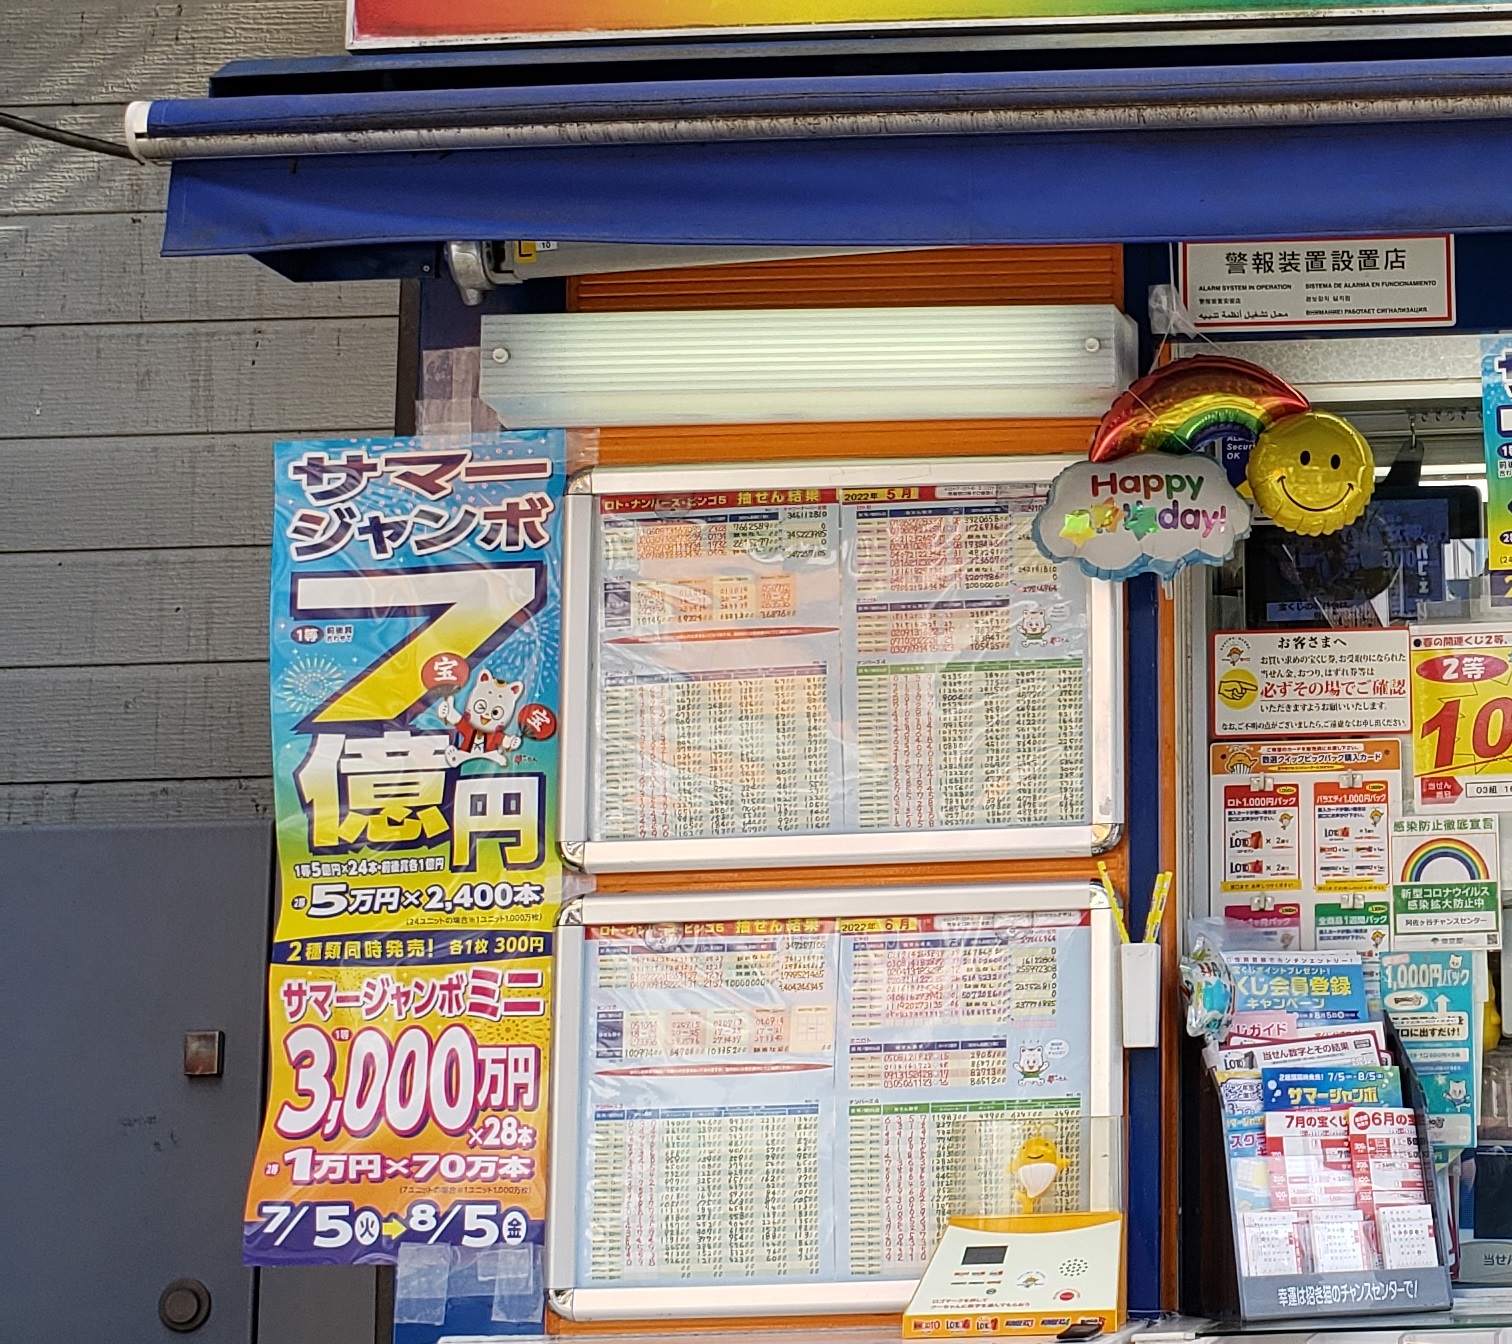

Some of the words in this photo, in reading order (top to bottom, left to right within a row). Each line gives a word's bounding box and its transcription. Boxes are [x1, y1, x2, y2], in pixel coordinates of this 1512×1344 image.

[1225, 248, 1407, 274] 警報装置設置店
[288, 450, 553, 506] サマー
[1091, 472, 1204, 501] Happy
[843, 492, 879, 502] 2022年
[886, 488, 913, 500] 5月
[286, 494, 556, 561] ジャンボ
[296, 628, 319, 643] 1等
[1278, 636, 1347, 650] お客さまへ
[433, 656, 458, 684] 宝
[1442, 657, 1486, 679] 2等
[1260, 679, 1407, 698] 必ずその場でご確認
[1394, 818, 1494, 832] 感染防止徹底宣言
[1401, 886, 1490, 899] 新型コロナウイルス
[1408, 898, 1485, 910] 感染拡大防止中
[842, 923, 877, 932] 2022年
[884, 918, 911, 931] 6月
[287, 938, 435, 962] 2種類同時発売!
[450, 938, 488, 955] 各1枚
[494, 936, 545, 954] 300円
[281, 967, 546, 1022] サマージャンボミニ
[1246, 998, 1326, 1009] キャンペーン
[1262, 1042, 1350, 1062] 当せん数字とその結果
[274, 1024, 541, 1139] 3,000万円
[1287, 1086, 1379, 1104] サマージャンボ
